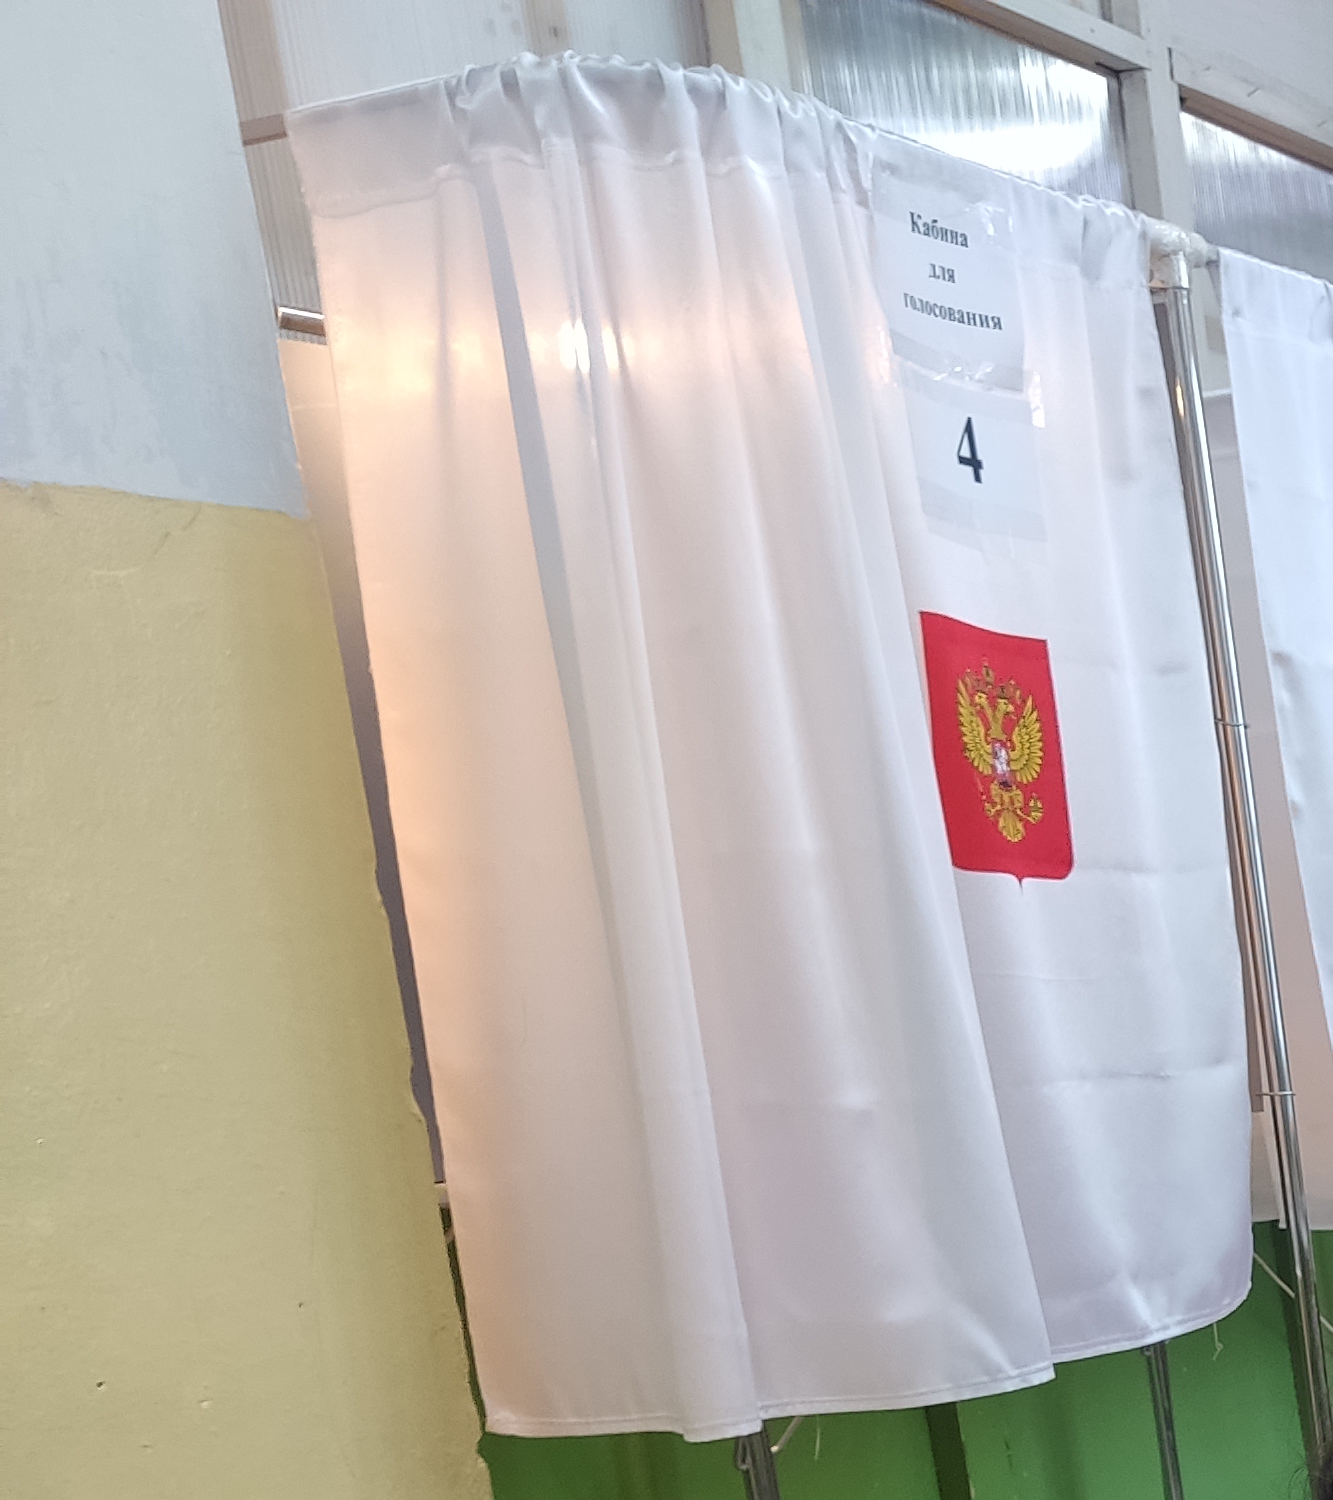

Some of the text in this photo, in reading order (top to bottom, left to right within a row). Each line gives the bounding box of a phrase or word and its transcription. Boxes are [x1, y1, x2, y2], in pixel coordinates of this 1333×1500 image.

[909, 211, 969, 248] Кабина
[928, 263, 956, 284] для
[903, 292, 1002, 331] голосования
[957, 416, 984, 484] 4
